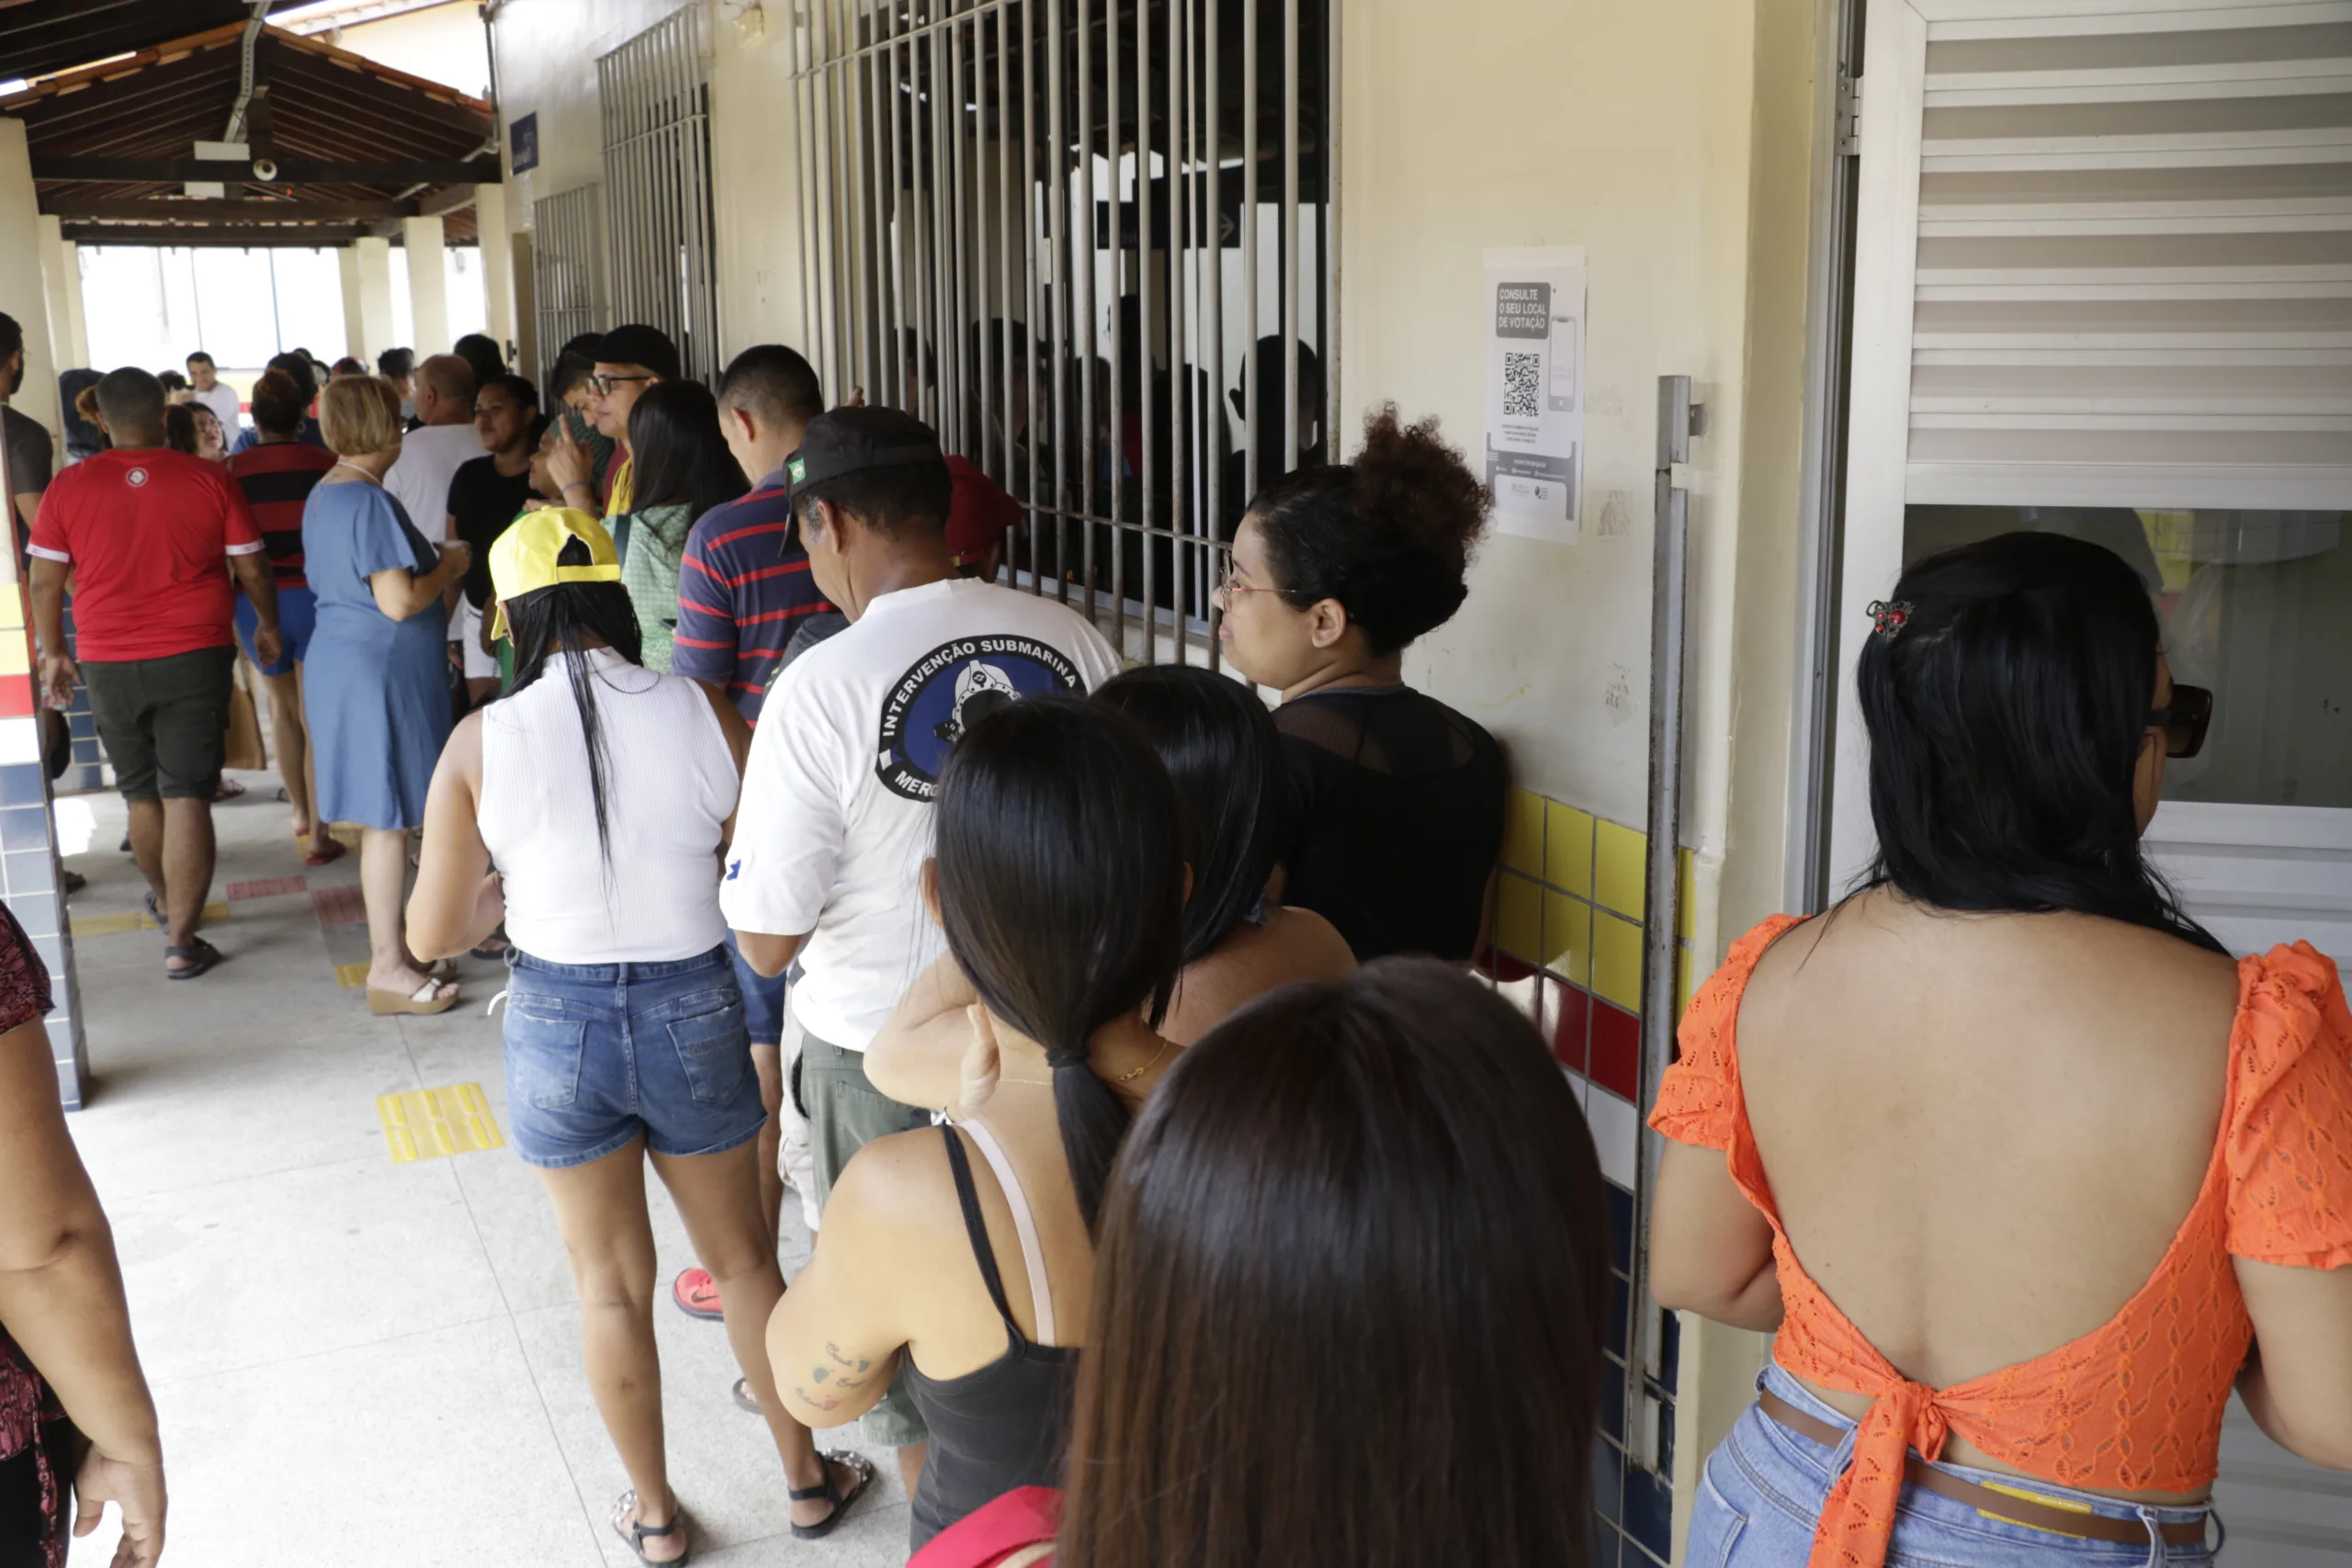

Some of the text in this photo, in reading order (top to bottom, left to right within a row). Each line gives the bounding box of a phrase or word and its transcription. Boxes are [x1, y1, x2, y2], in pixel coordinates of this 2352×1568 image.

[1499, 288, 1538, 300] CONSULTE
[1498, 302, 1546, 315] O SEU LOCAL
[1498, 315, 1545, 332] DE VOTAÇÃO
[882, 639, 1077, 737] INTERVENÇÃO SUBMARINA
